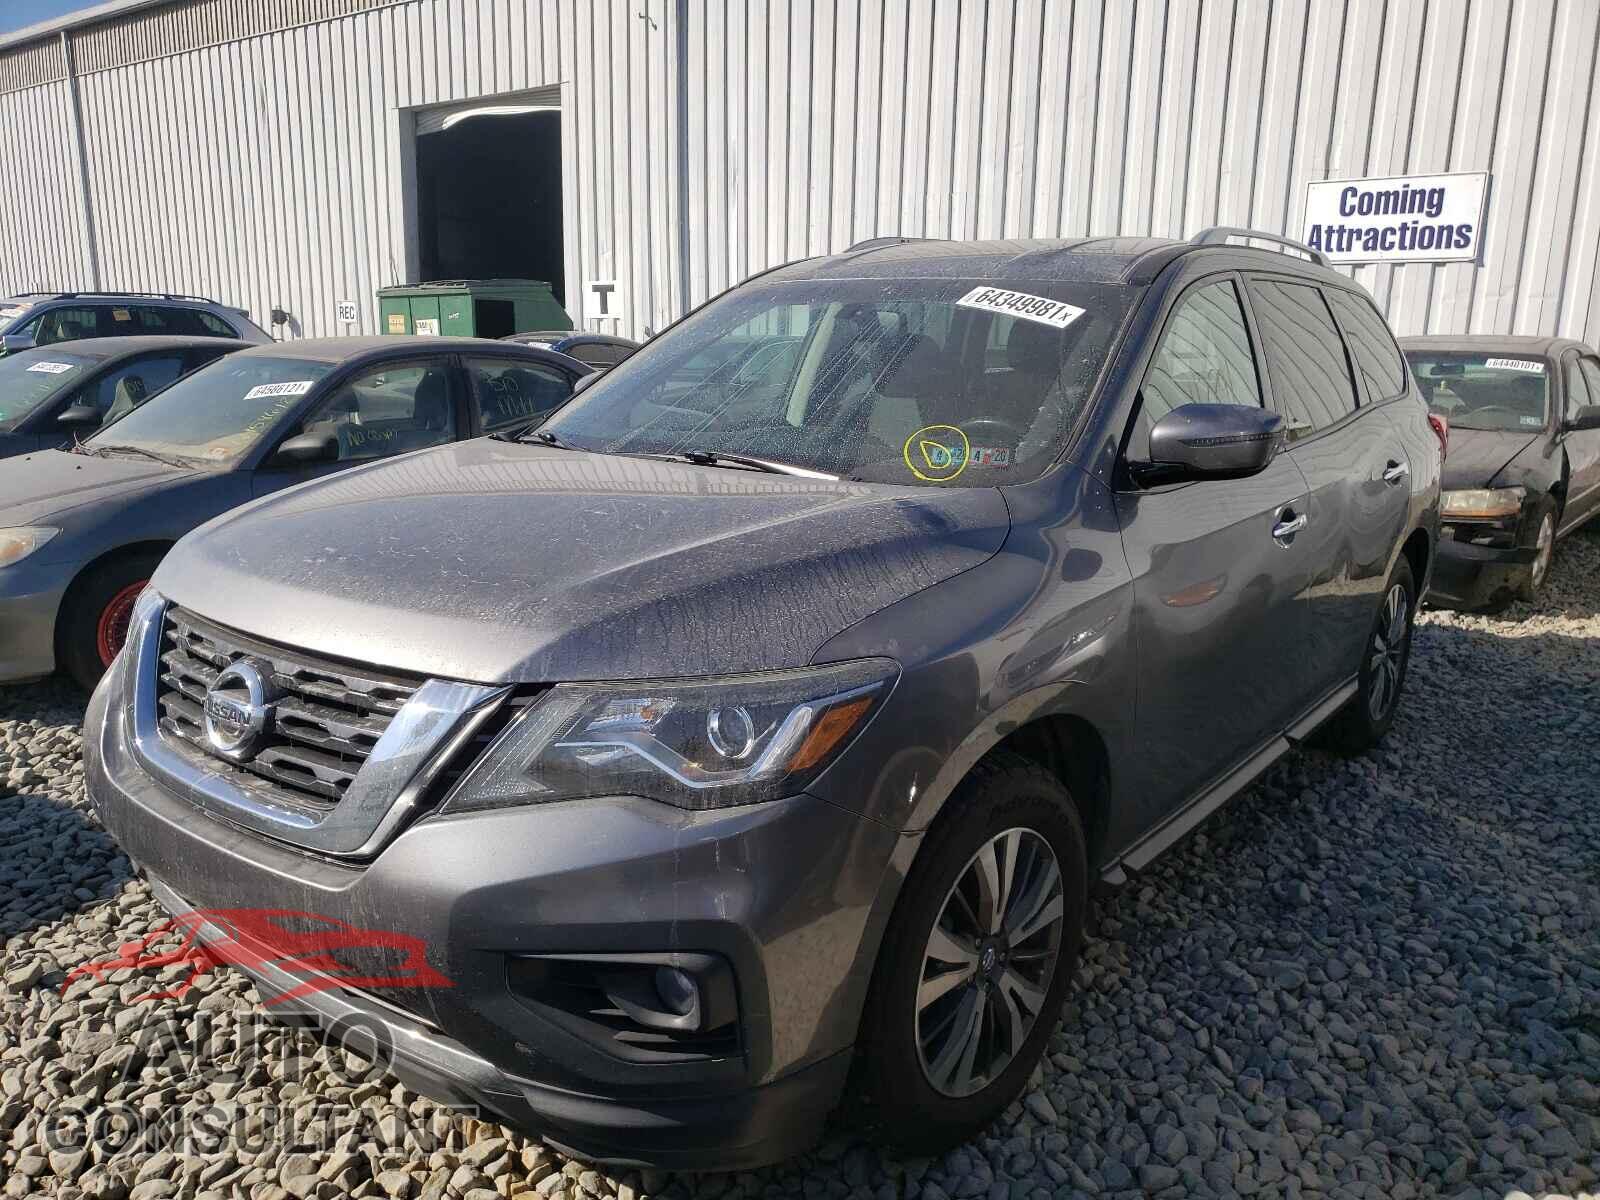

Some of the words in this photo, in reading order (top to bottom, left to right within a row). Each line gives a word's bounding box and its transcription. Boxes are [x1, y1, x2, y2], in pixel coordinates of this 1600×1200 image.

[1339, 184, 1445, 217] Coming
[1308, 220, 1472, 252] Attractions
[339, 306, 355, 319] REC
[592, 285, 614, 314] T
[206, 698, 251, 727] NISSAN
